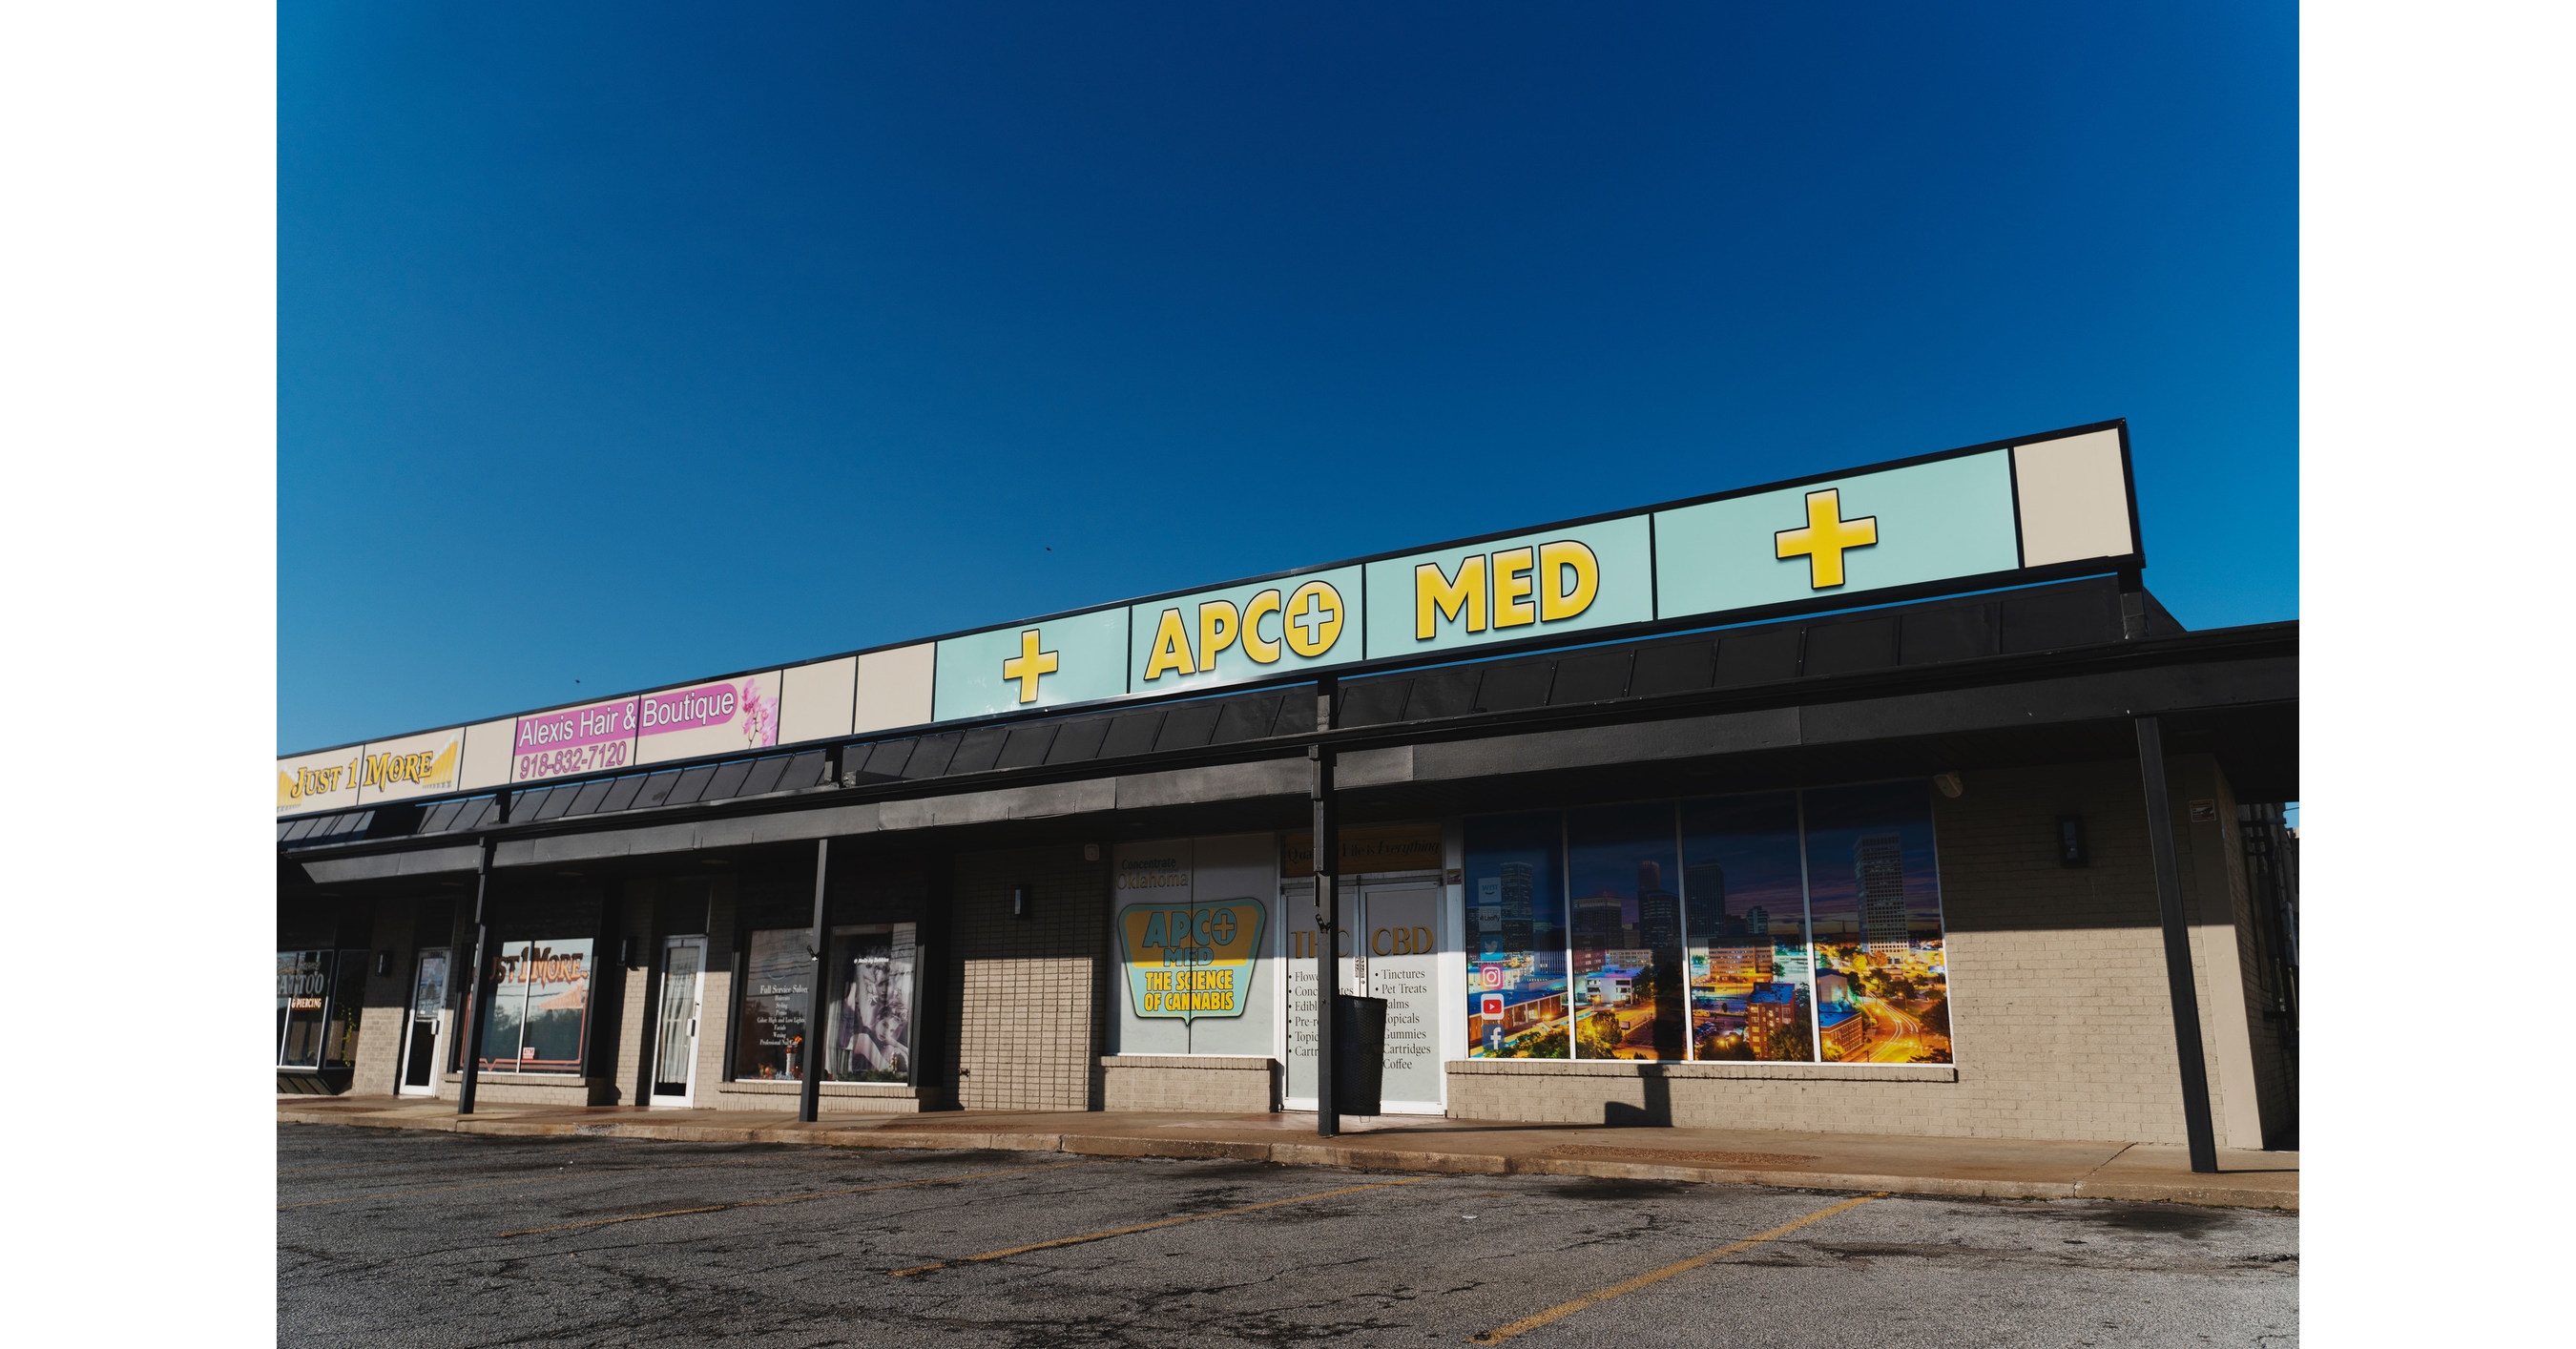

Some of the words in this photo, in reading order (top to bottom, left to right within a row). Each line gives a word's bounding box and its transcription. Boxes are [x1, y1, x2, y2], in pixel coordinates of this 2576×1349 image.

[1144, 580, 1344, 681] APCO
[1415, 540, 1600, 641] MED
[518, 715, 573, 748] Alexis
[579, 707, 618, 738] Hair
[623, 701, 636, 731] &
[642, 692, 735, 728] Boutique
[519, 740, 627, 779] 918-832-7120
[290, 766, 343, 799] JUST
[345, 758, 358, 790] 1
[363, 750, 433, 793] MORE
[1366, 843, 1375, 856] is
[1378, 839, 1441, 856] Everything
[1121, 858, 1176, 870] Concentrate
[1116, 871, 1189, 890] Oklahoma
[1142, 908, 1237, 948] APCO
[1372, 925, 1434, 957] CBD
[1163, 947, 1214, 967] MED
[277, 973, 324, 994] ATTOO
[1145, 971, 1172, 991] THE
[1175, 969, 1234, 991] SCIENCE
[1381, 969, 1425, 980] Tinctures
[759, 985, 772, 994] Full
[772, 985, 792, 994] Service
[793, 984, 808, 994] Salon
[1381, 984, 1397, 994] Pet
[1399, 983, 1427, 994] Treats
[297, 998, 322, 1008] PIERCING
[1144, 992, 1162, 1011] OF
[1164, 991, 1234, 1011] CANNABIS
[1386, 998, 1410, 1009] alms
[1383, 1028, 1427, 1040] Gummies
[1383, 1043, 1431, 1057] Cartridges
[1382, 1058, 1413, 1069] Coffee
